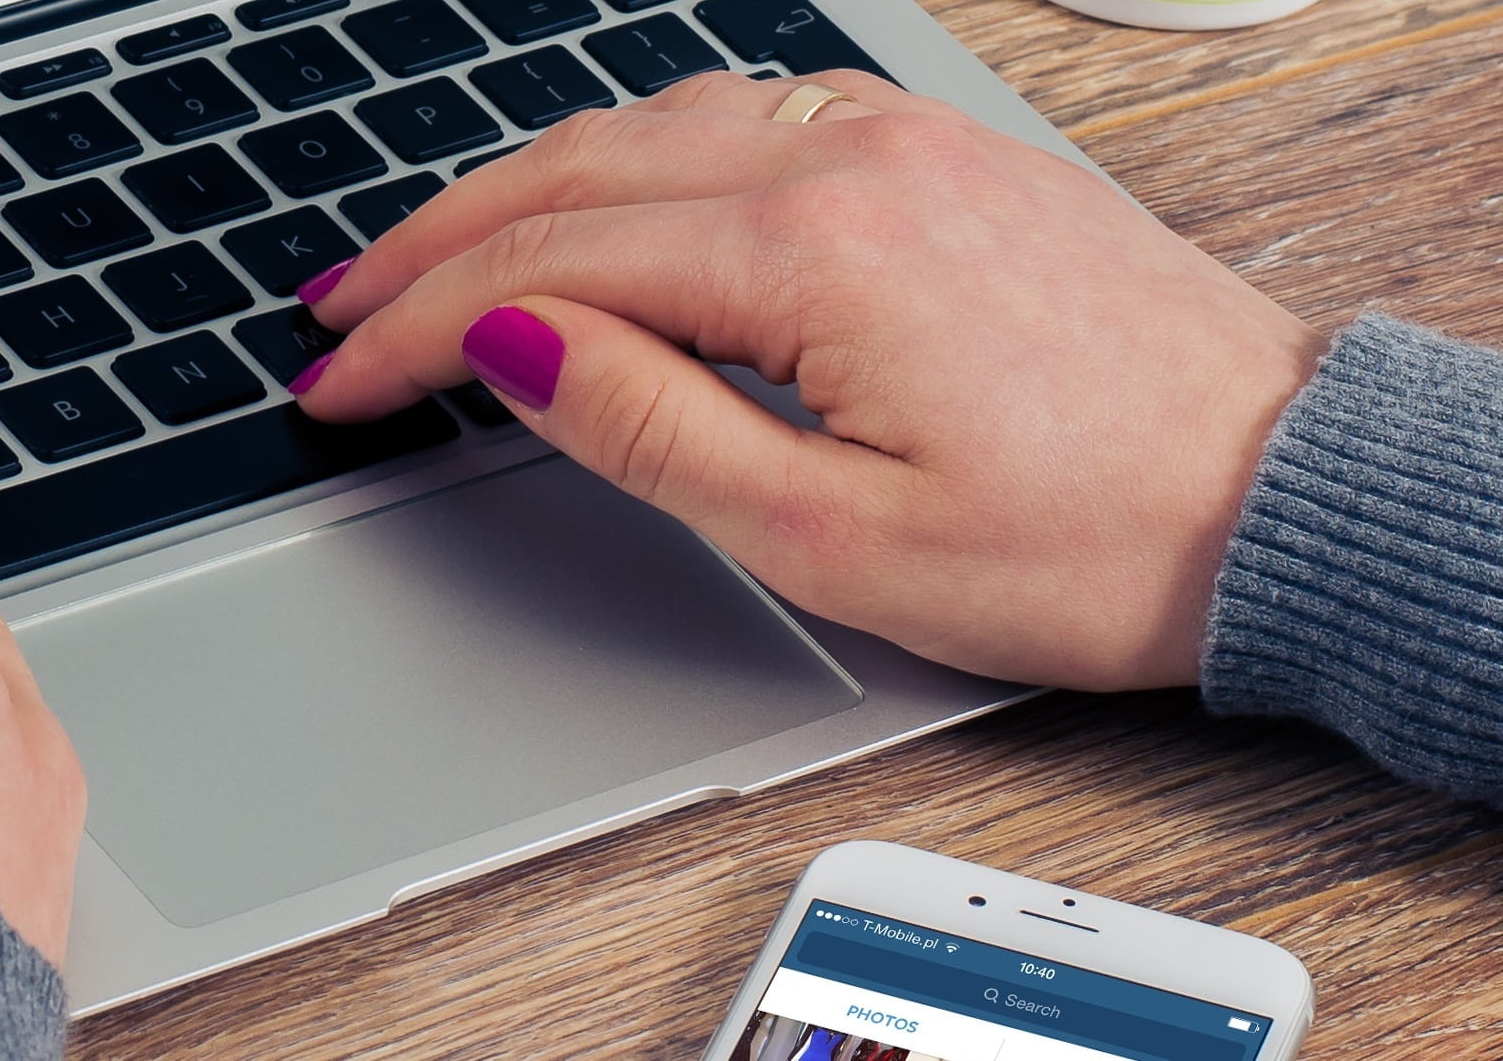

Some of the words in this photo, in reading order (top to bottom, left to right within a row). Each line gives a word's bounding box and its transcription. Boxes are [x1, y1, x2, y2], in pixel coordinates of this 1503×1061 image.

[185, 98, 205, 116] 9
[414, 106, 437, 126] P
[67, 133, 91, 150] 8
[60, 207, 92, 228] U
[281, 235, 314, 257] K
[170, 272, 188, 292] J
[41, 305, 75, 329] H
[171, 360, 207, 384] N
[52, 400, 81, 421] B
[863, 919, 939, 950] T-Mobile.pl
[1019, 961, 1056, 981] 10:40
[1004, 993, 1061, 1019] Search
[846, 1004, 920, 1033] PHOTOS
